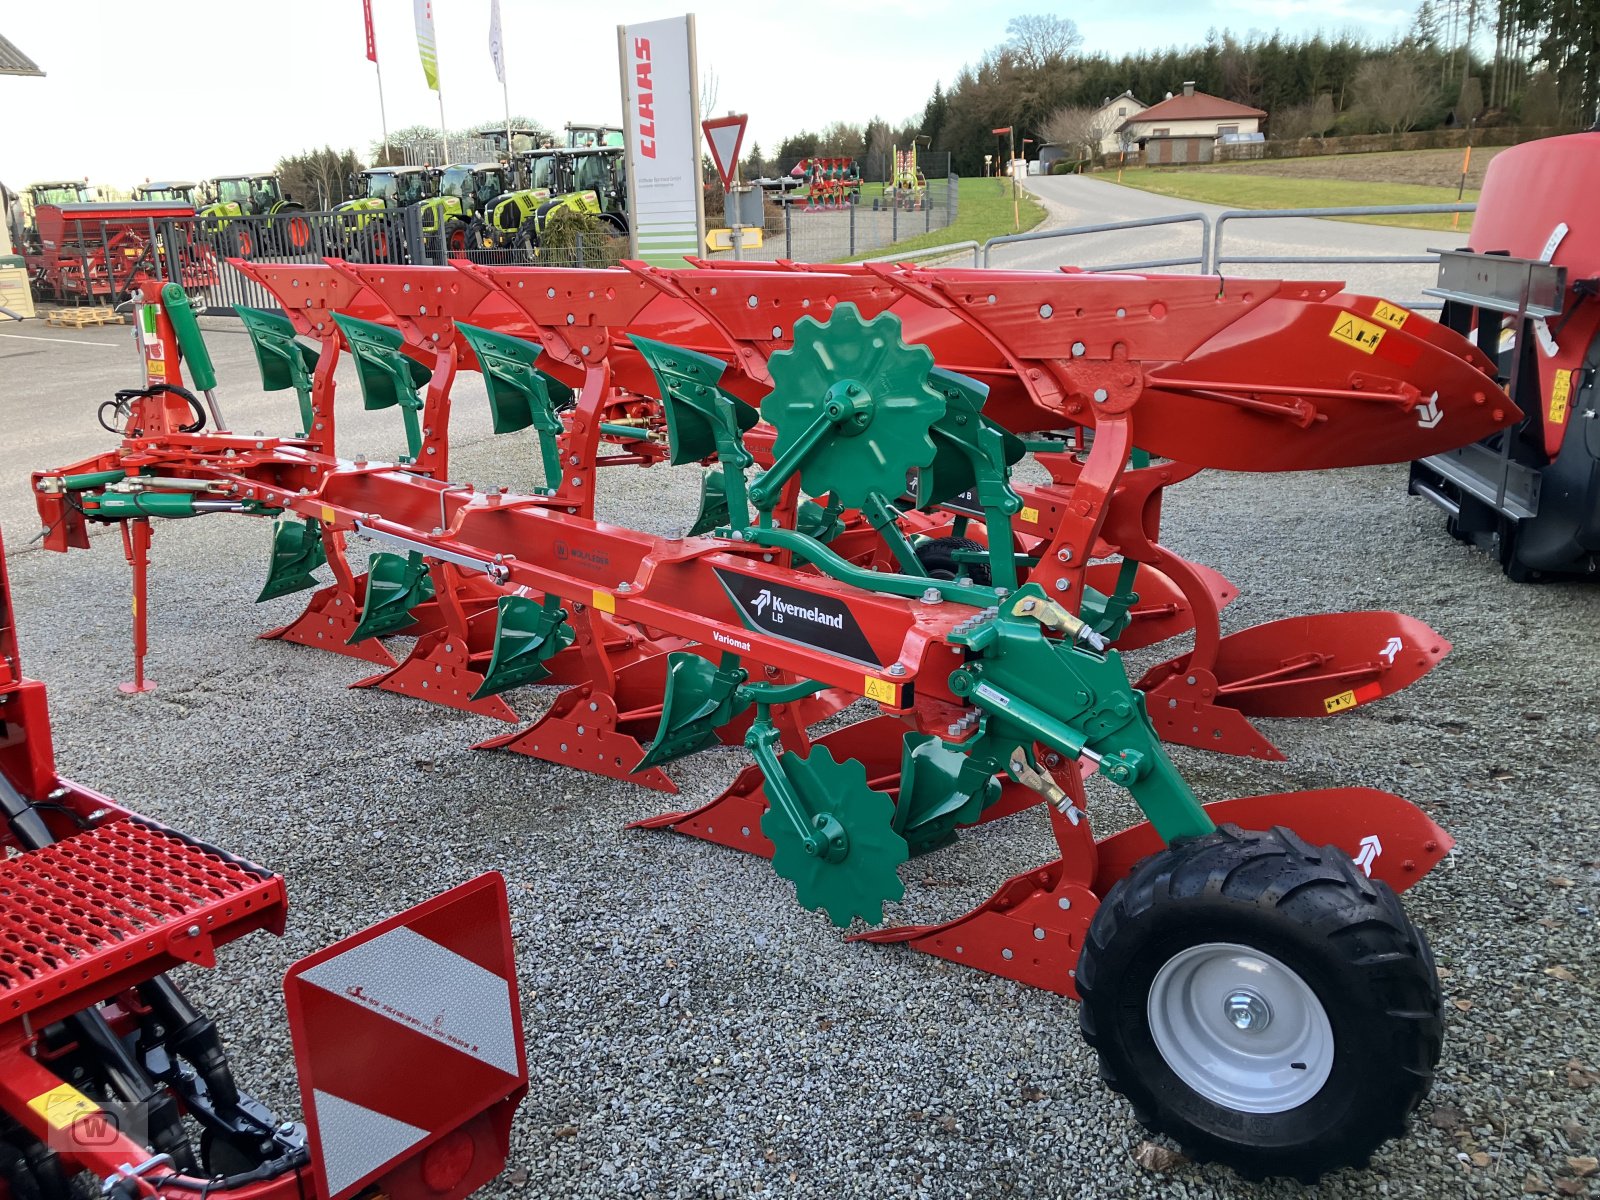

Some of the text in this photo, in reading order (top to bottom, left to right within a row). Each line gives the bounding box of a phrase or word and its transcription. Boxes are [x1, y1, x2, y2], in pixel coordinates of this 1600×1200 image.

[635, 37, 656, 159] CLAAS
[966, 491, 972, 500] B
[772, 595, 843, 629] Kverneland
[772, 611, 784, 624] LB
[712, 630, 751, 652] Variomat
